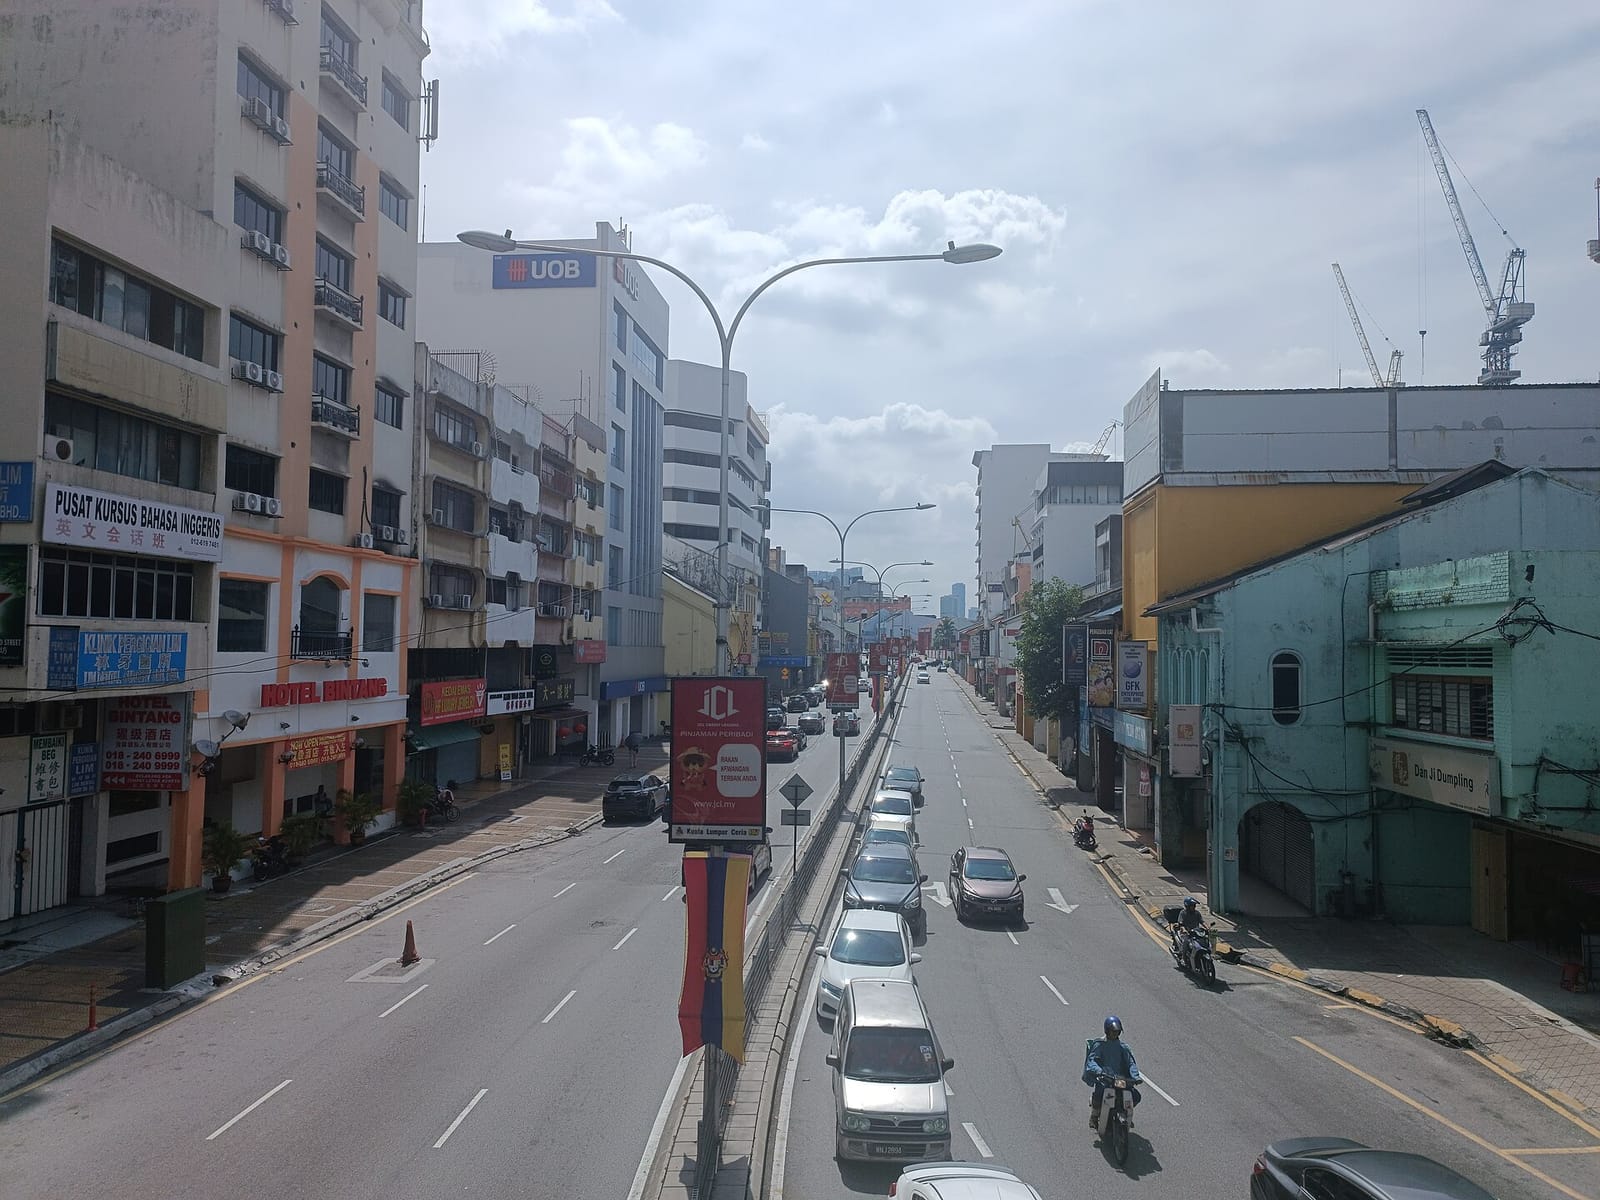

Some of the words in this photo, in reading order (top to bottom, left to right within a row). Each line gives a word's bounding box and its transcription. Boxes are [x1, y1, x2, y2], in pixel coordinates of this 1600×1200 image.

[532, 260, 580, 279] UOB
[624, 265, 639, 301] UOB
[56, 490, 93, 518] PUSAT
[95, 498, 137, 526] KURSUS
[141, 505, 178, 533] BAHASA
[180, 513, 220, 539] INGGERIS
[56, 517, 166, 550] 英文会话班
[4, 639, 21, 647] STREET
[84, 633, 117, 654] KLINIK
[166, 633, 182, 653] LIM
[261, 682, 321, 707] HOTEL
[323, 678, 387, 702] BINTANG
[1125, 682, 1140, 691] GFK
[119, 695, 172, 709] HOTEL
[109, 710, 181, 724] BINTANG
[304, 736, 319, 749] OPEN
[41, 750, 56, 760] BEG
[133, 751, 152, 760] 240
[75, 764, 94, 774] LIM
[133, 761, 151, 770] 240
[1414, 764, 1428, 780] Dan
[1429, 767, 1436, 782] Ji
[1436, 770, 1474, 792] Dumpling
[693, 801, 736, 809] www.jcl.my
[706, 828, 728, 836] Lumpur
